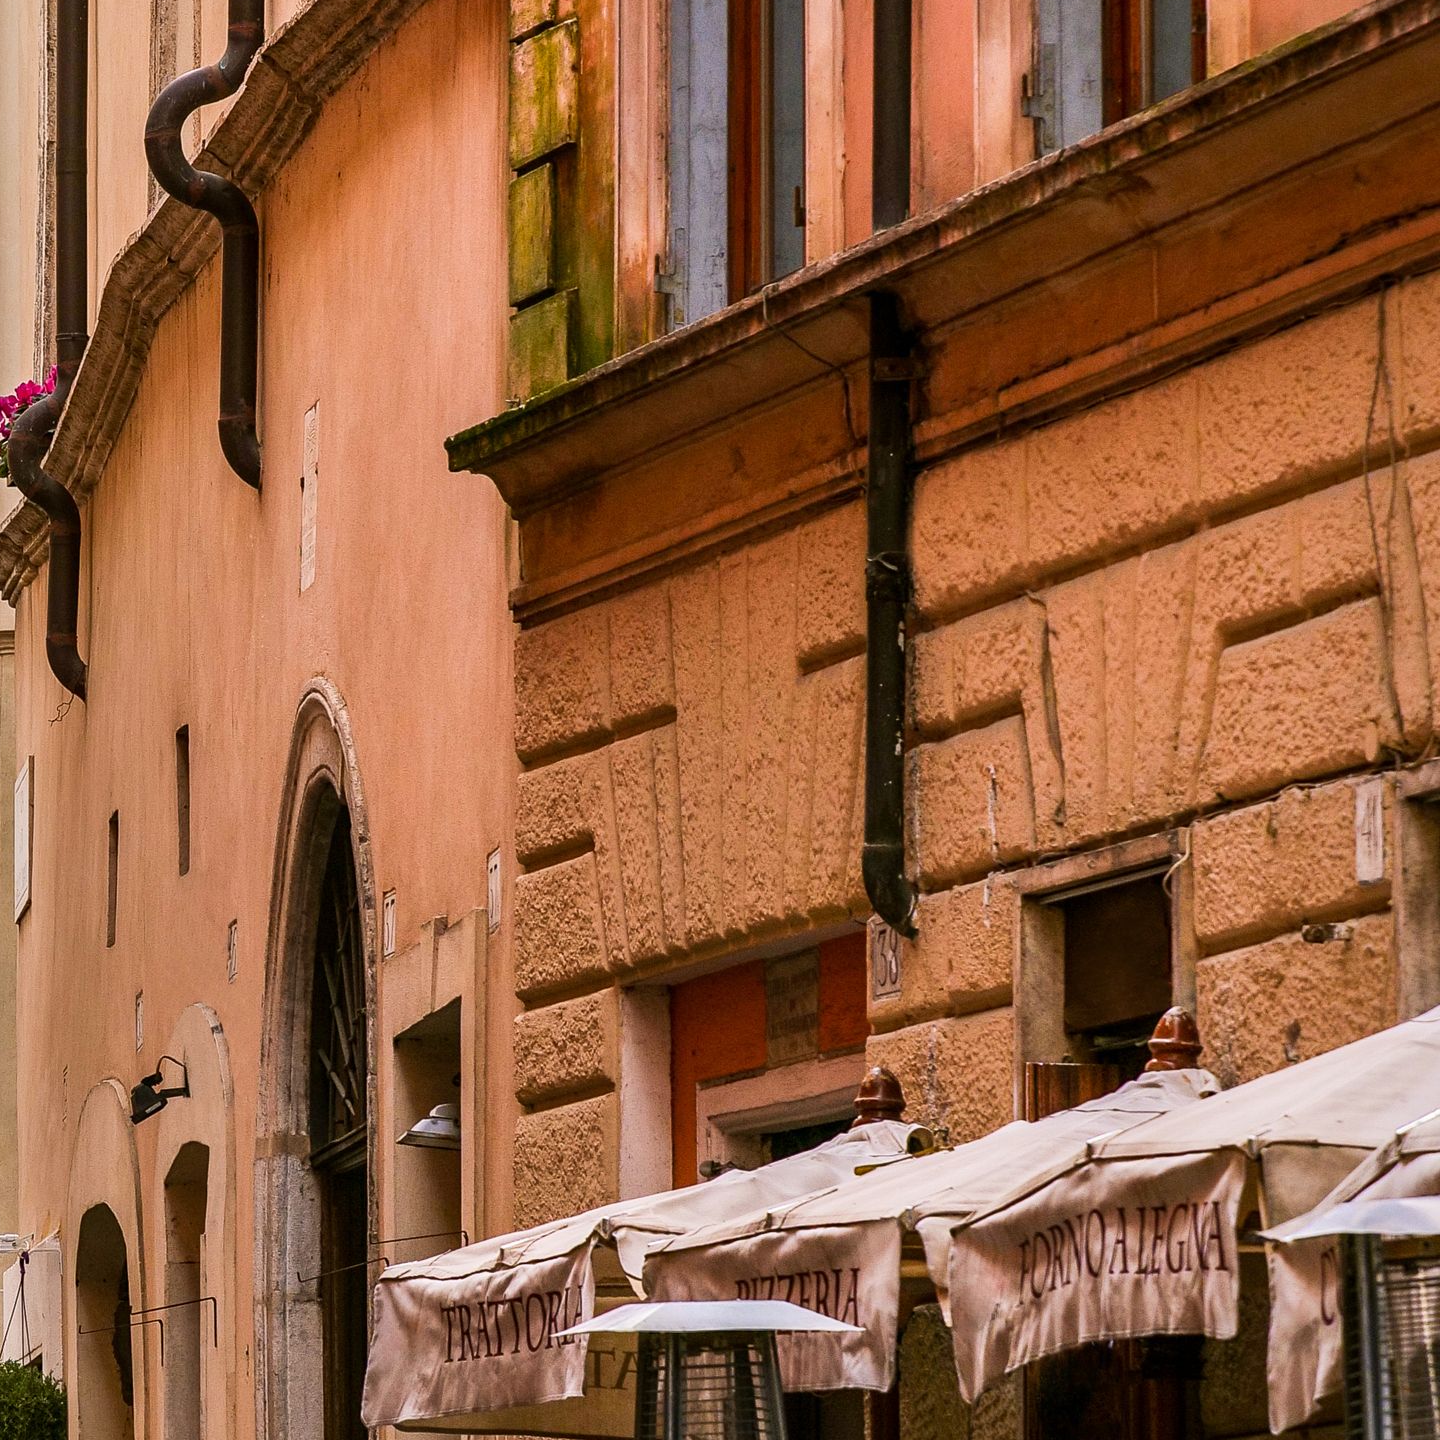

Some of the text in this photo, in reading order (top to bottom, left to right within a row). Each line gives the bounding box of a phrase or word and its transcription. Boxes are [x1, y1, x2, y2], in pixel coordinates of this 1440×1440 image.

[876, 926, 899, 987] 38
[1016, 1200, 1230, 1307] FORNO A LEGNA
[440, 1284, 583, 1363] TRATTORIA
